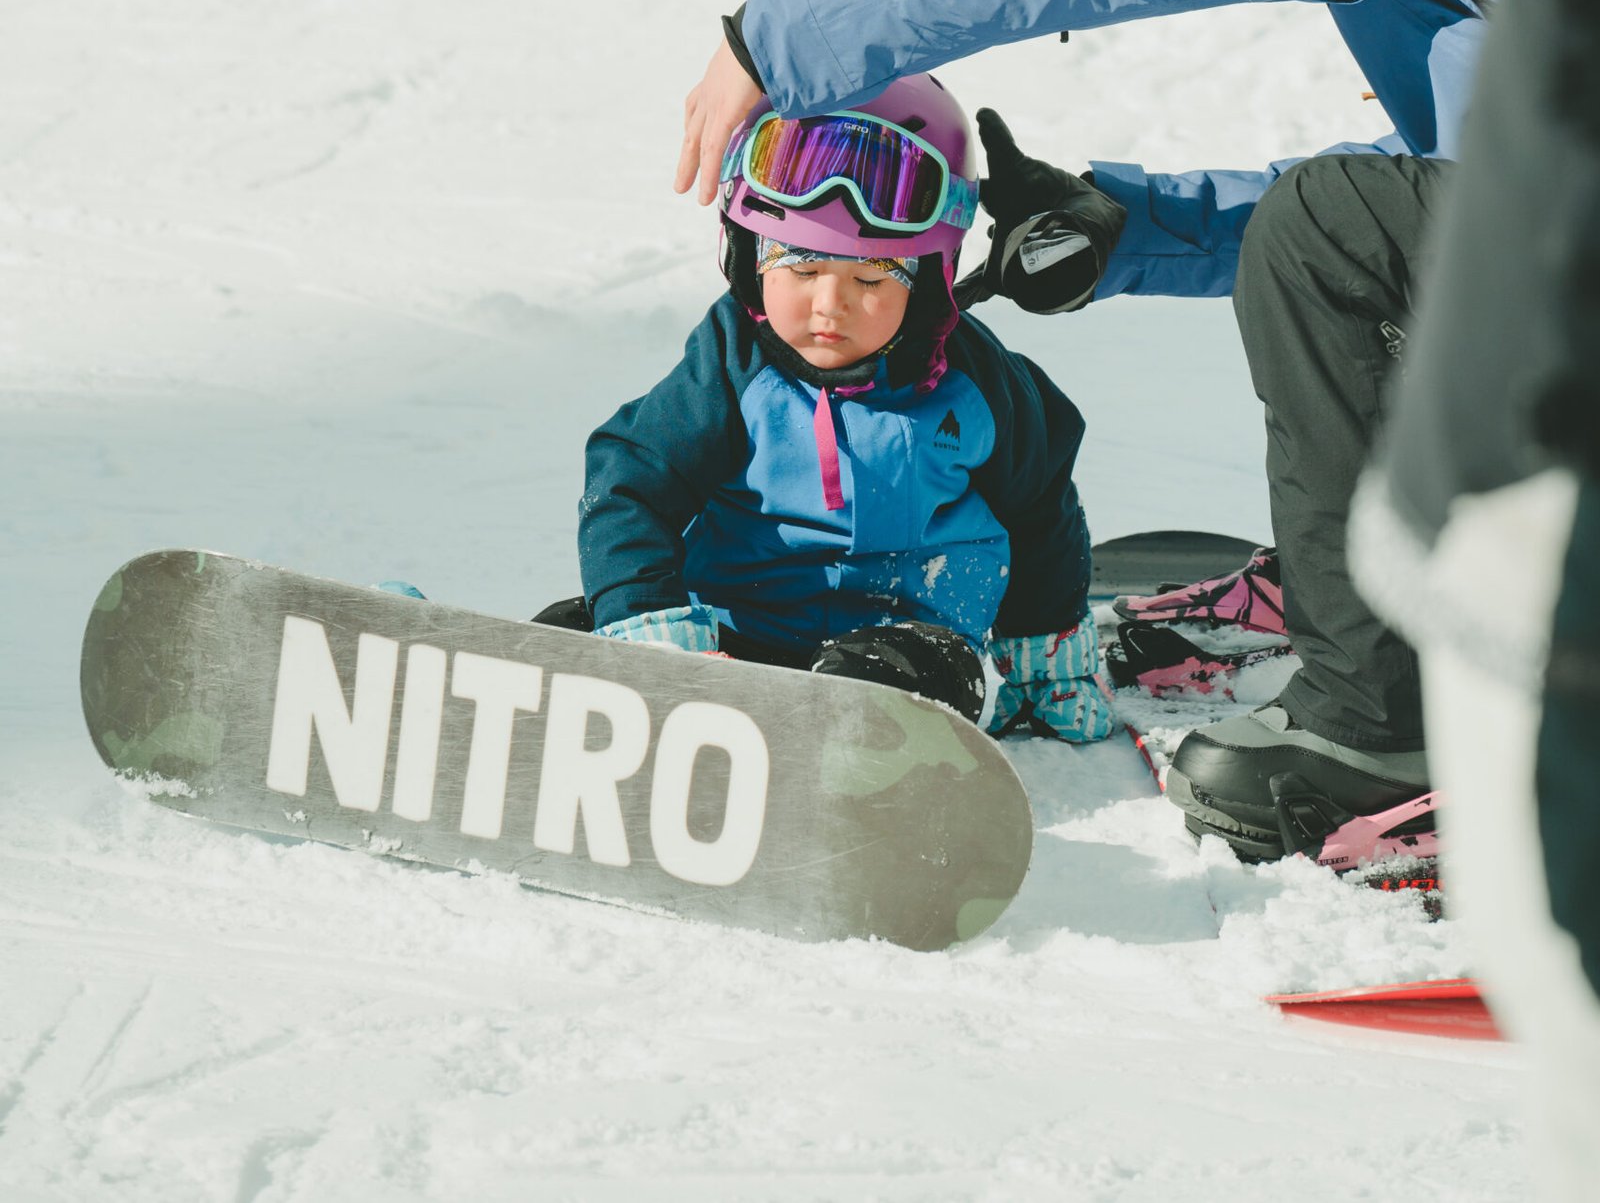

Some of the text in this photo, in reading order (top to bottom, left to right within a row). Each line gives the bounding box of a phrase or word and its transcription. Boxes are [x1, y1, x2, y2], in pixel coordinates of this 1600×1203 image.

[844, 122, 869, 134] GIRO
[933, 441, 960, 451] BURTON
[266, 615, 769, 886] NITRO
